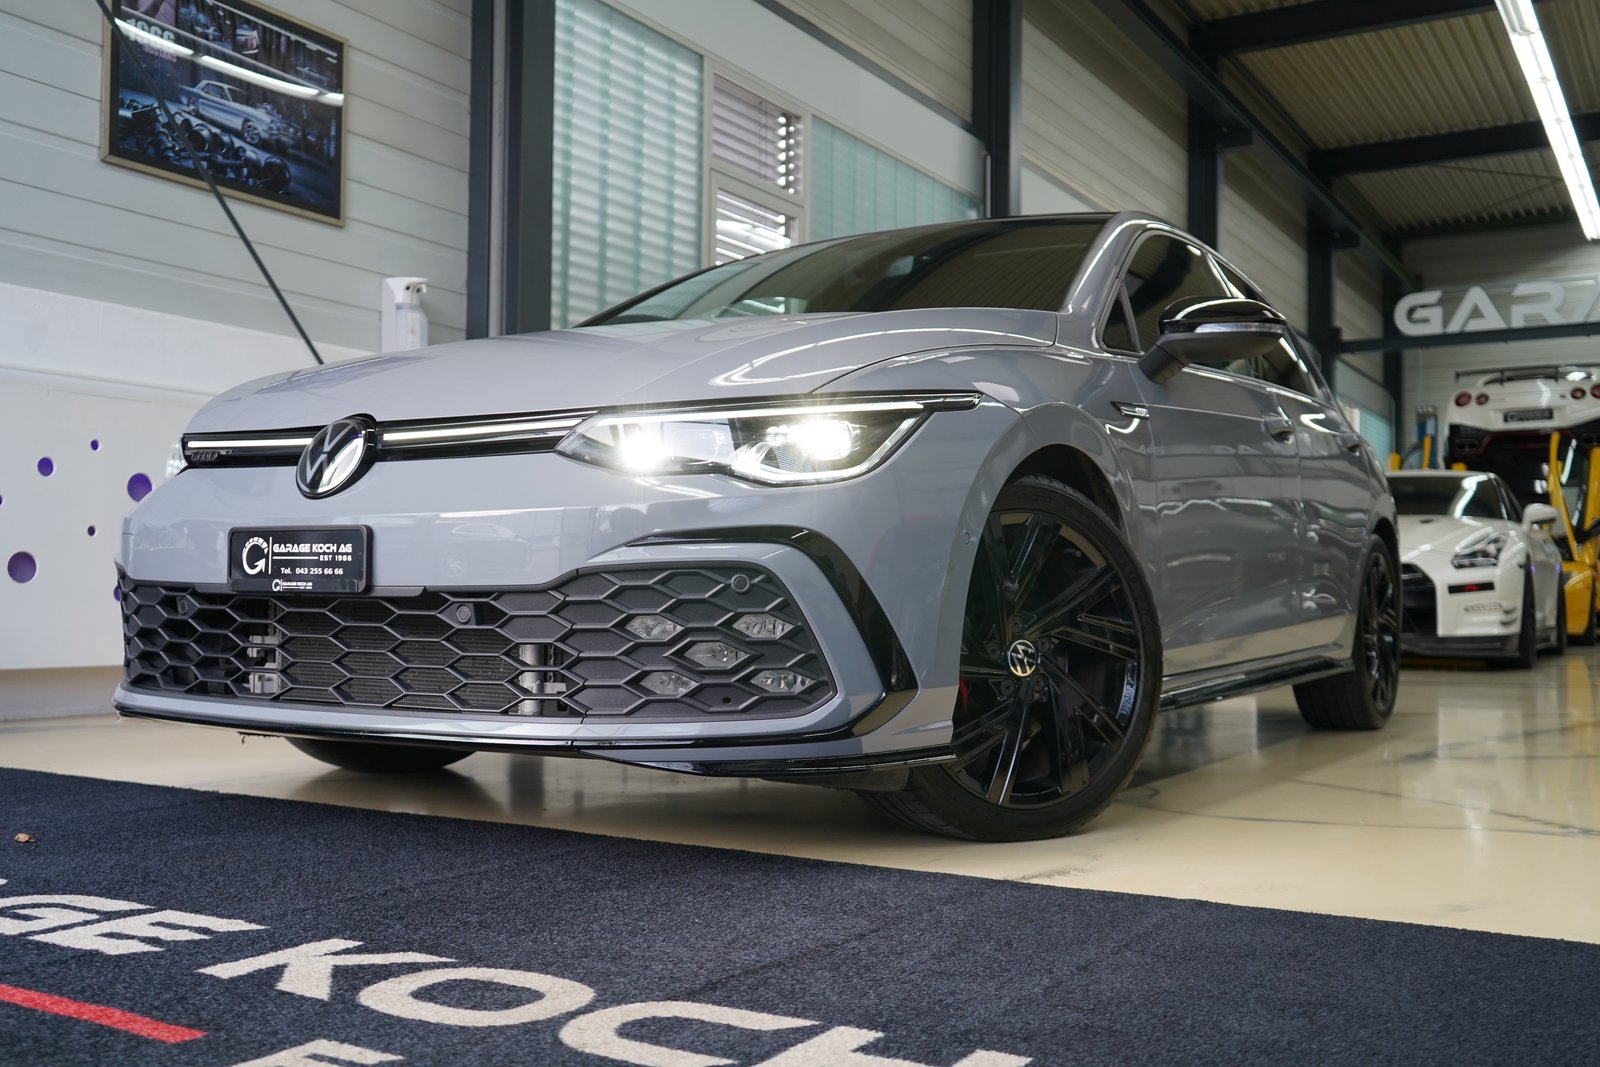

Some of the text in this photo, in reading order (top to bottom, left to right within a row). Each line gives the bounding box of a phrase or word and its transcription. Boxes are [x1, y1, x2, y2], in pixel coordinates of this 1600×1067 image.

[273, 543, 352, 553] GARAGE KOCH AG
[319, 554, 352, 562] EST 1986
[280, 567, 344, 575] Tel. 043 255 66 66
[0, 878, 270, 955] GE
